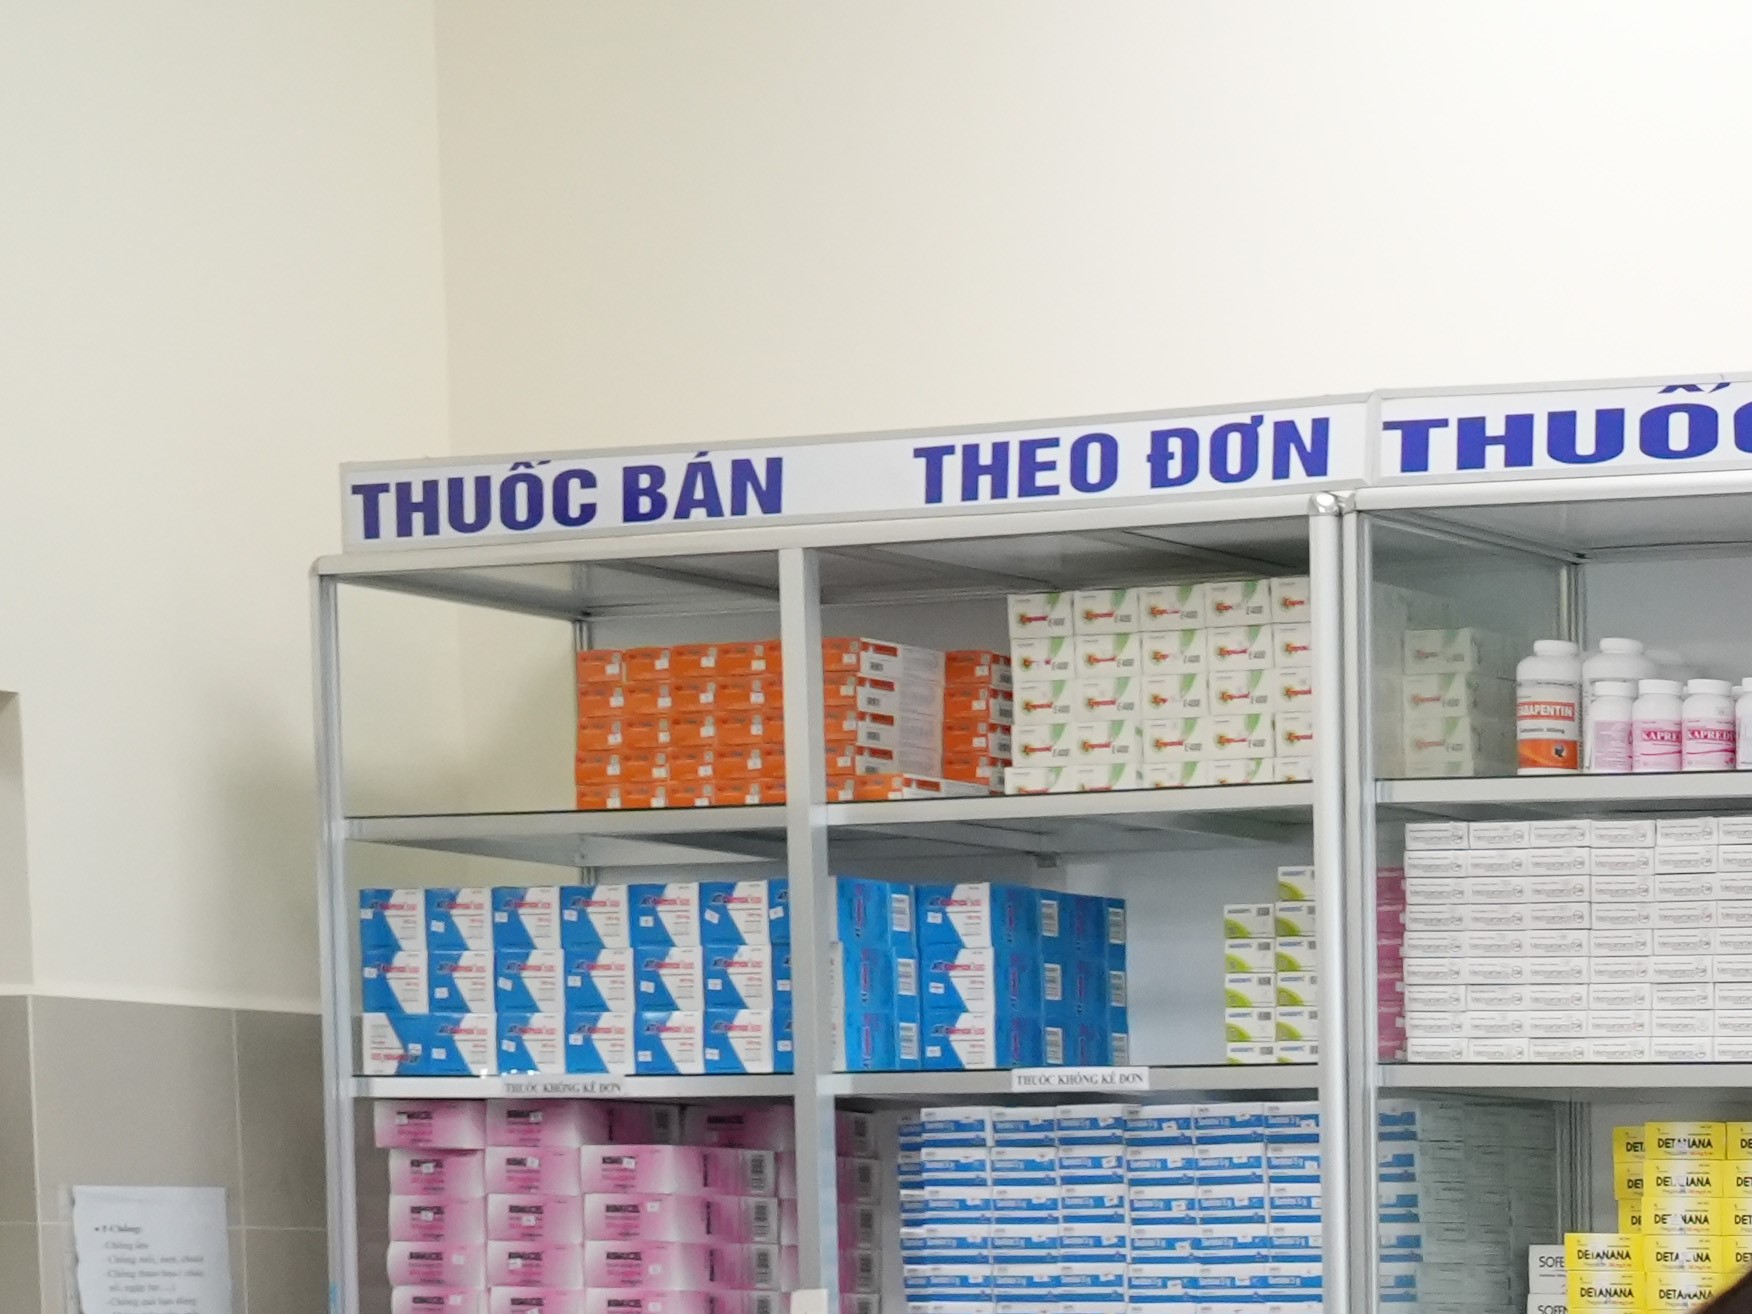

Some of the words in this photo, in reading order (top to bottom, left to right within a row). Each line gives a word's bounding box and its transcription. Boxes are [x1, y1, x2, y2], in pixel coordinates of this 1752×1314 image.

[350, 459, 597, 540] THUỐC
[622, 451, 783, 523] BÁN
[913, 433, 1118, 504] THEO
[1147, 414, 1330, 489] ĐƠN
